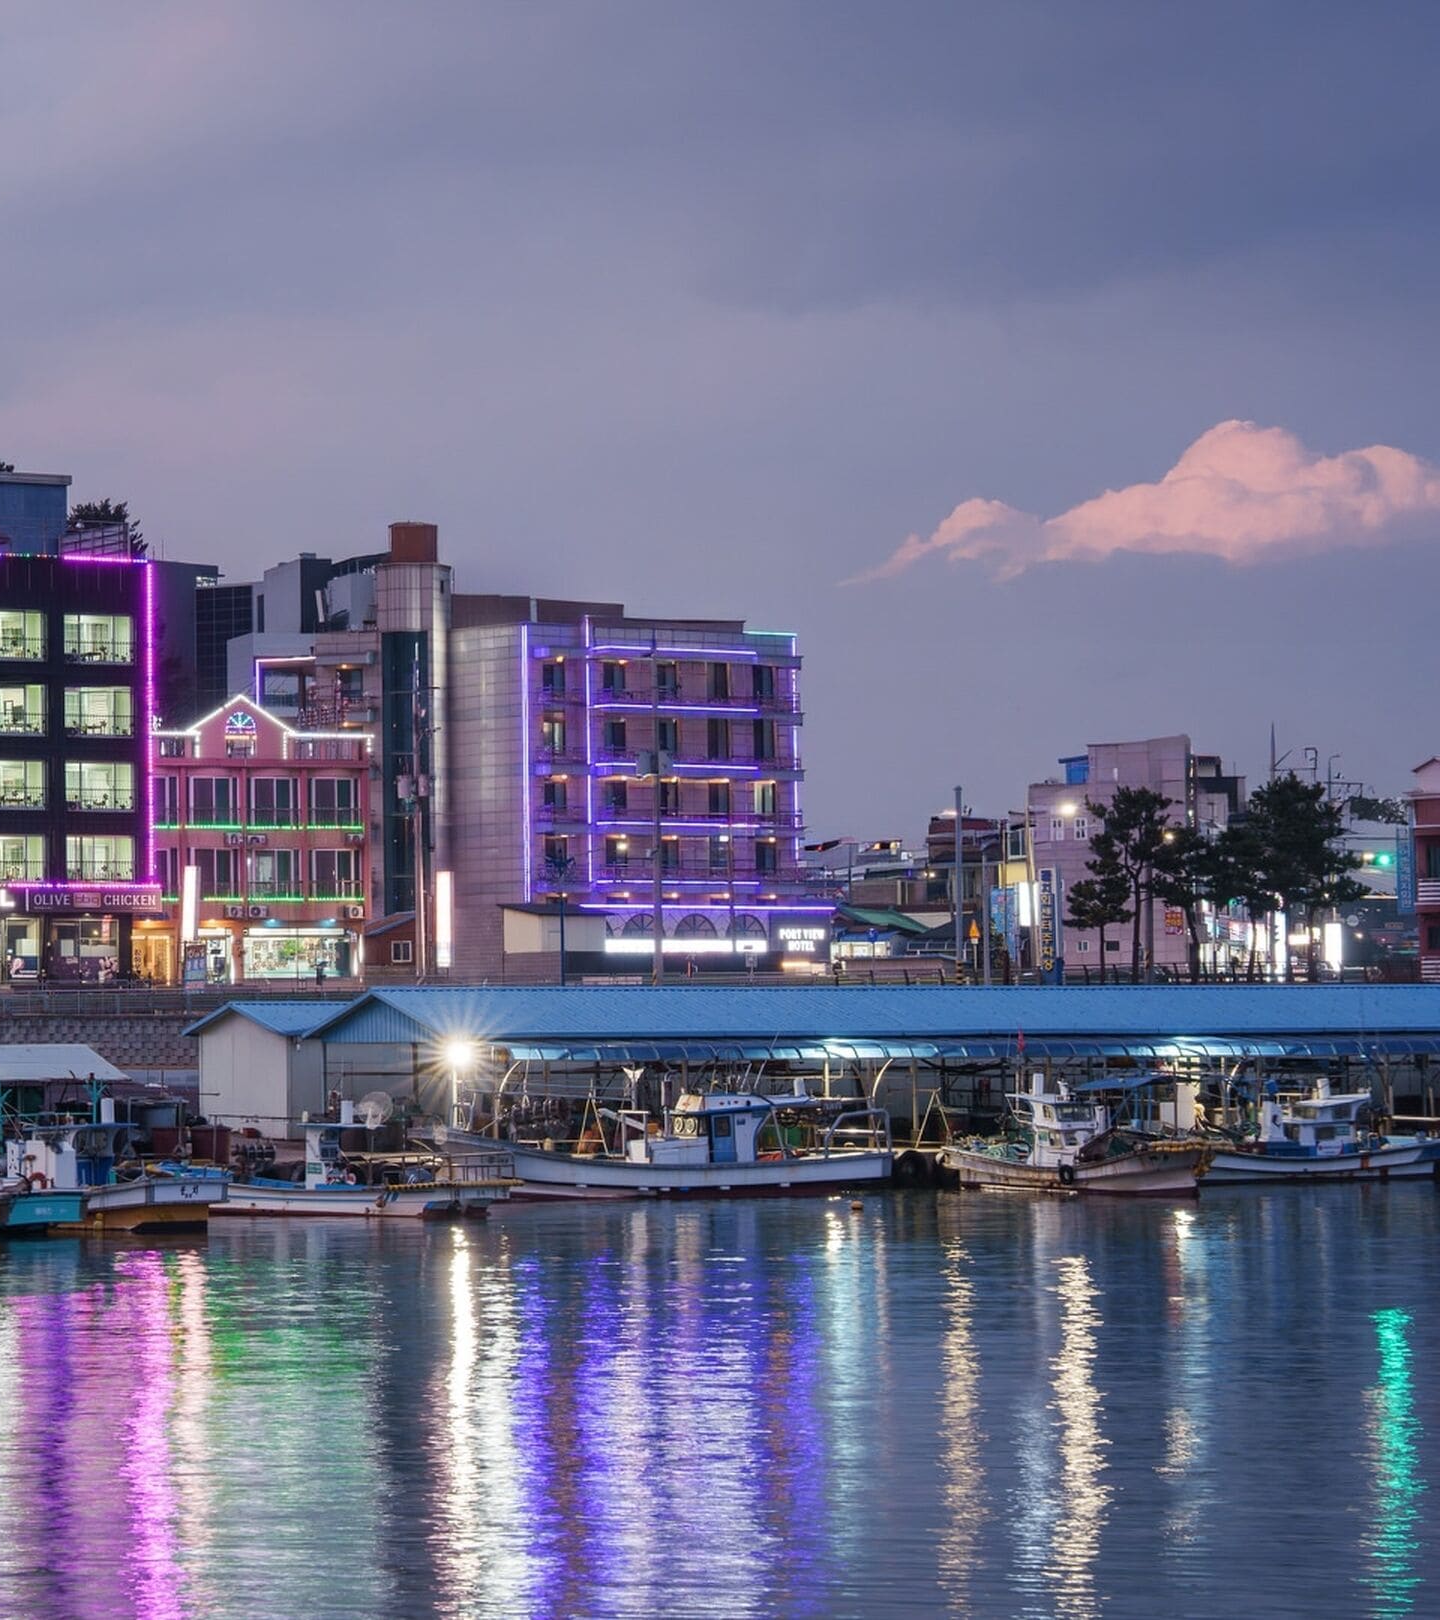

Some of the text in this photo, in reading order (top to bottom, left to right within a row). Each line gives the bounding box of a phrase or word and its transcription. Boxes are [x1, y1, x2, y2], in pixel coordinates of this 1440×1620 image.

[33, 894, 71, 906] OLIVE
[103, 894, 157, 906] CHICKEN
[779, 928, 825, 940] PORT VIEW
